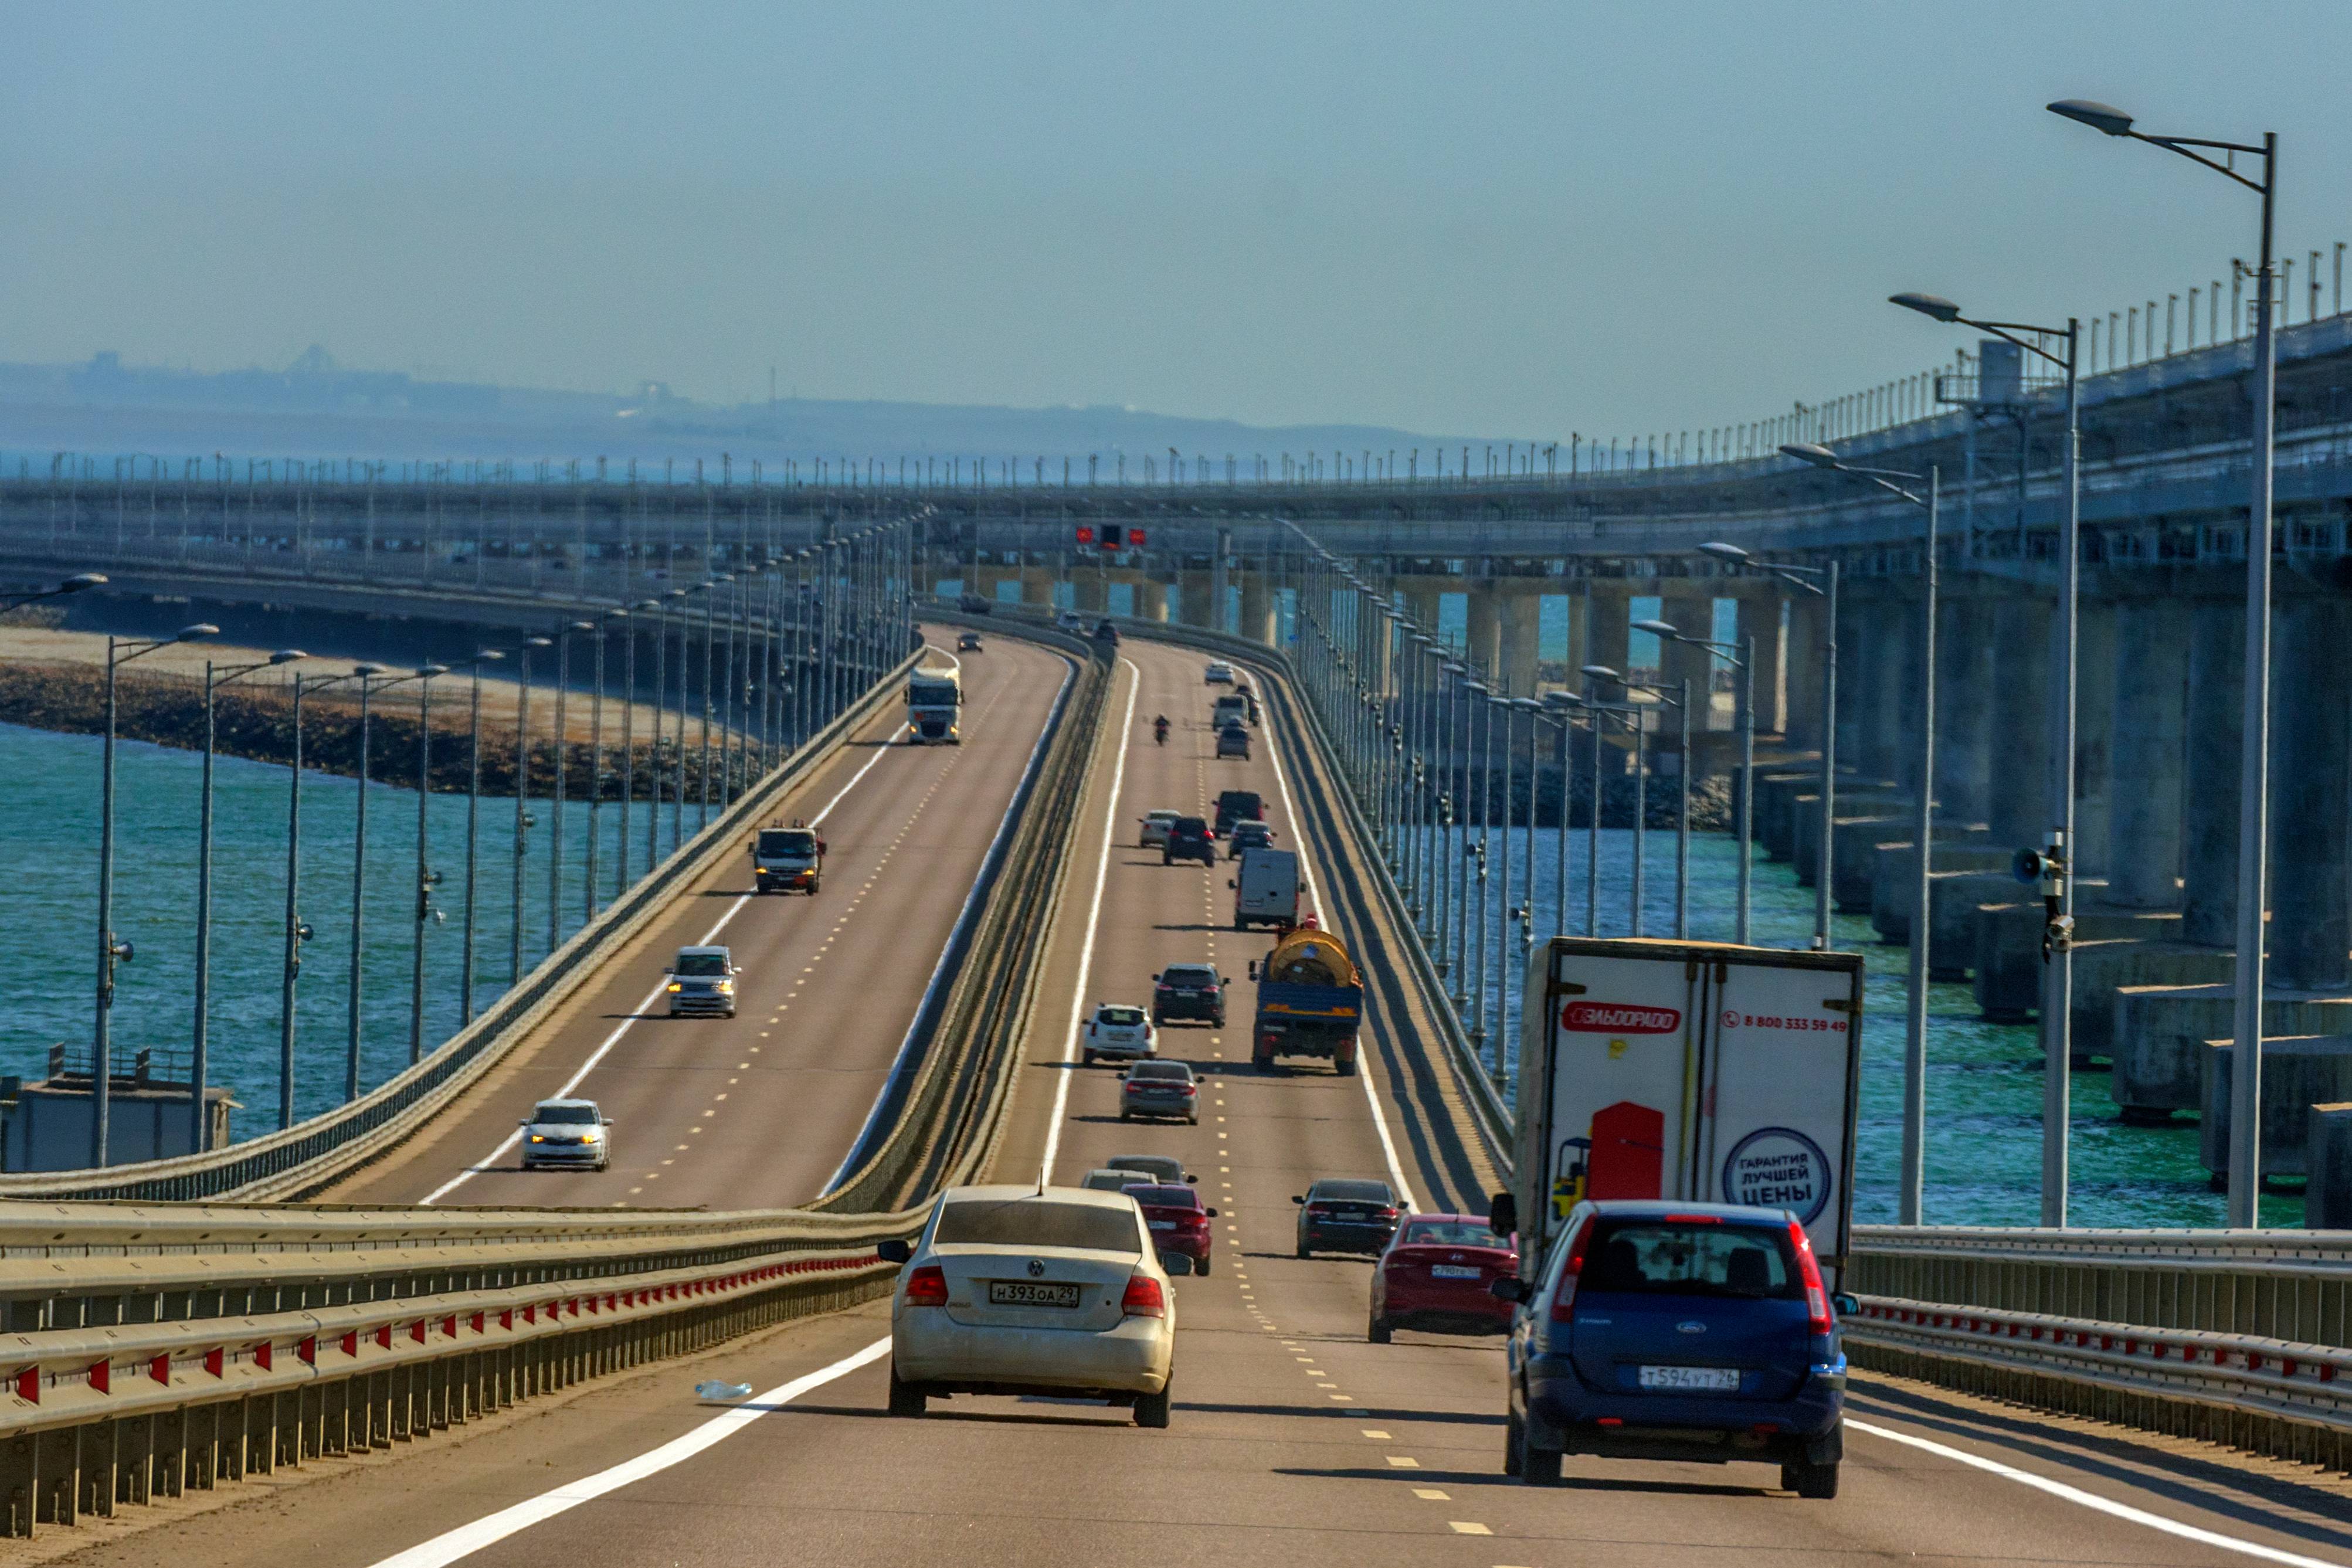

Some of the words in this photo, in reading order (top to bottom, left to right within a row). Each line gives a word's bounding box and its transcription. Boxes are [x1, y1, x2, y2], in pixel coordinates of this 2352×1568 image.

[1744, 1015, 1753, 1027] 8
[1757, 1016, 1783, 1029] 800
[1785, 1017, 1808, 1030] 333
[1811, 1019, 1828, 1031] 59
[1830, 1021, 1847, 1033] 49
[1740, 1153, 1808, 1169] ГАРАНТИЯ
[1743, 1165, 1808, 1183] ЛУЧШЕЙ
[1743, 1185, 1811, 1206] ЦЕНЫ
[1060, 1287, 1074, 1298] 29
